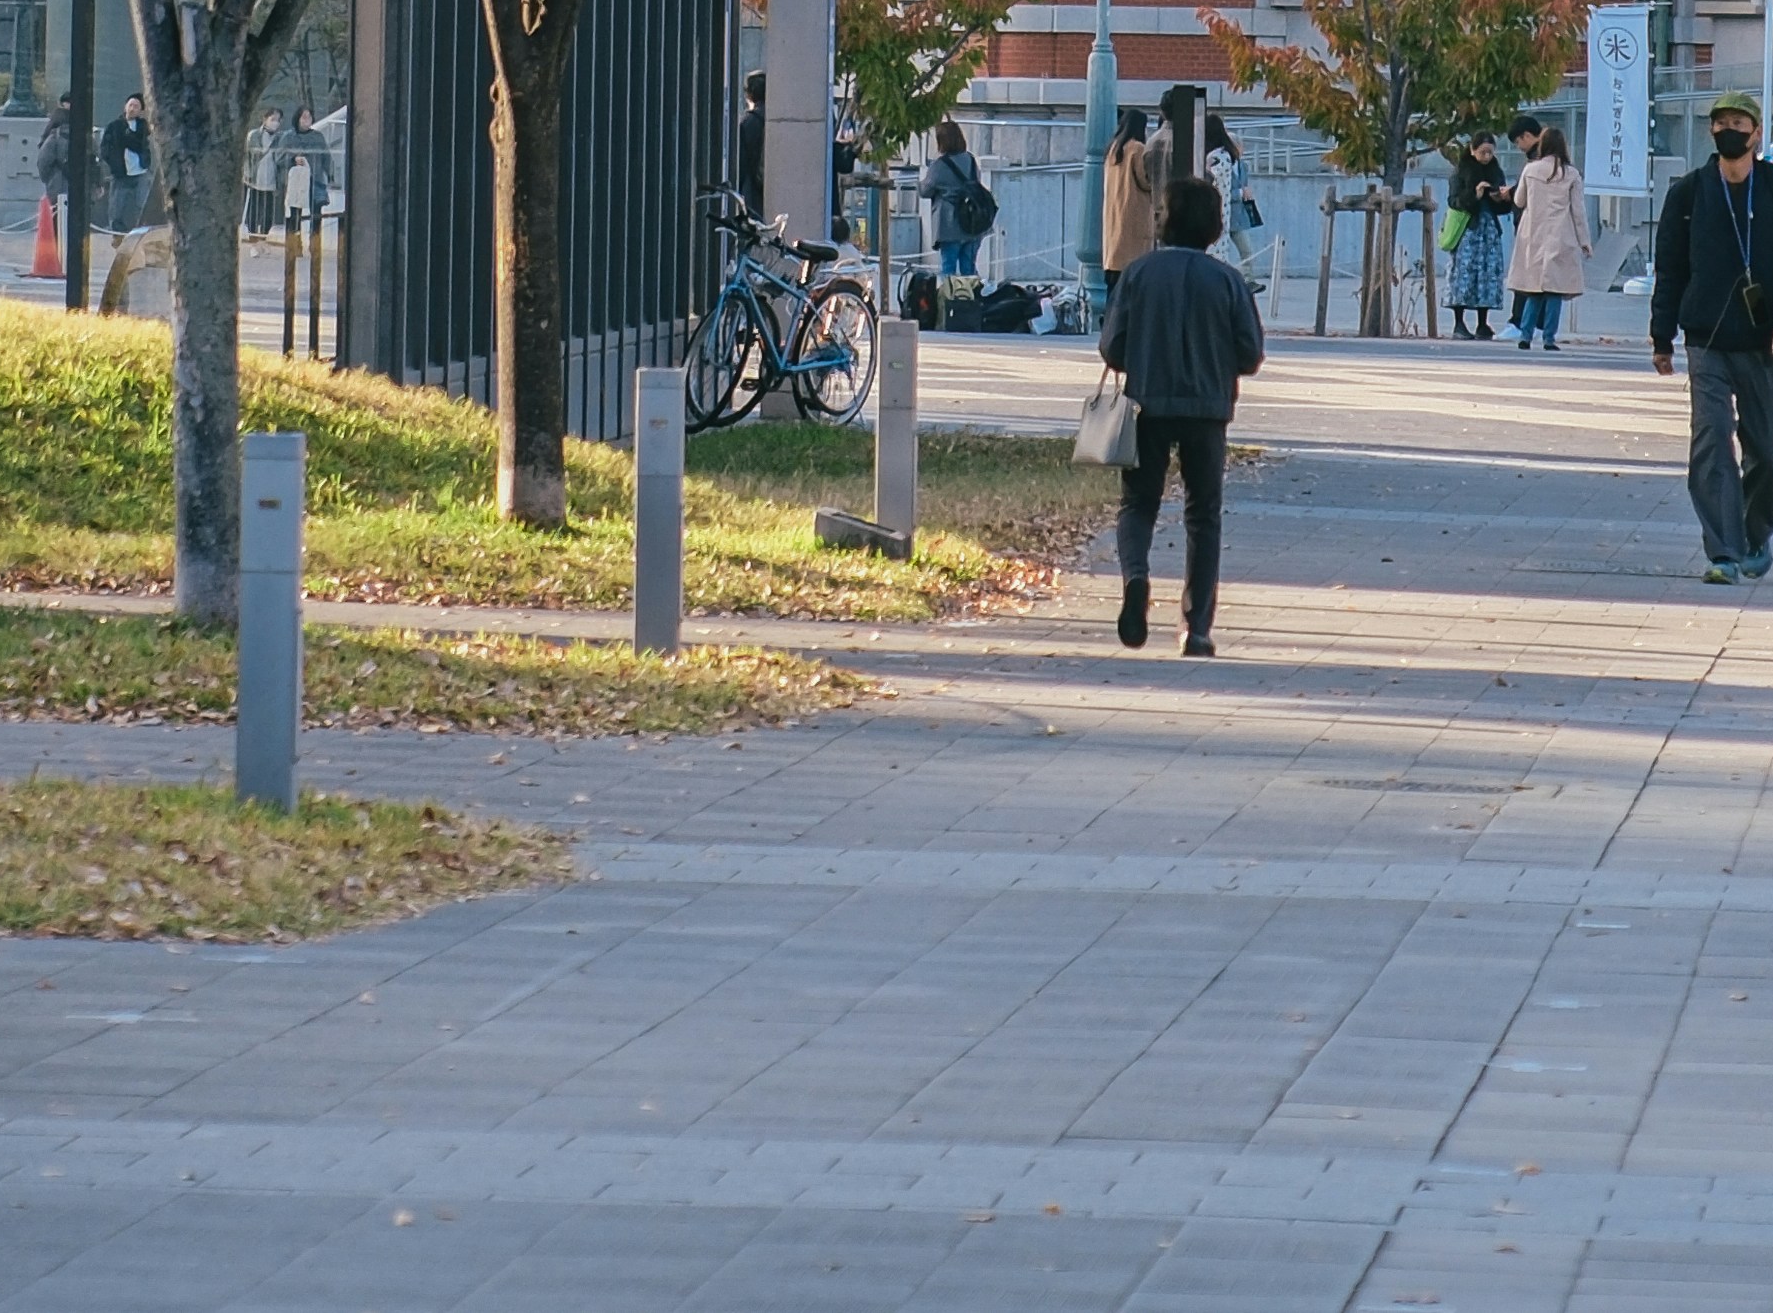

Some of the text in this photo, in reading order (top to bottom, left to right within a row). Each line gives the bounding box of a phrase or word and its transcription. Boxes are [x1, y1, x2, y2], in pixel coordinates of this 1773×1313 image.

[1604, 33, 1631, 62] 米
[1609, 77, 1625, 178] おにぎり専門店
